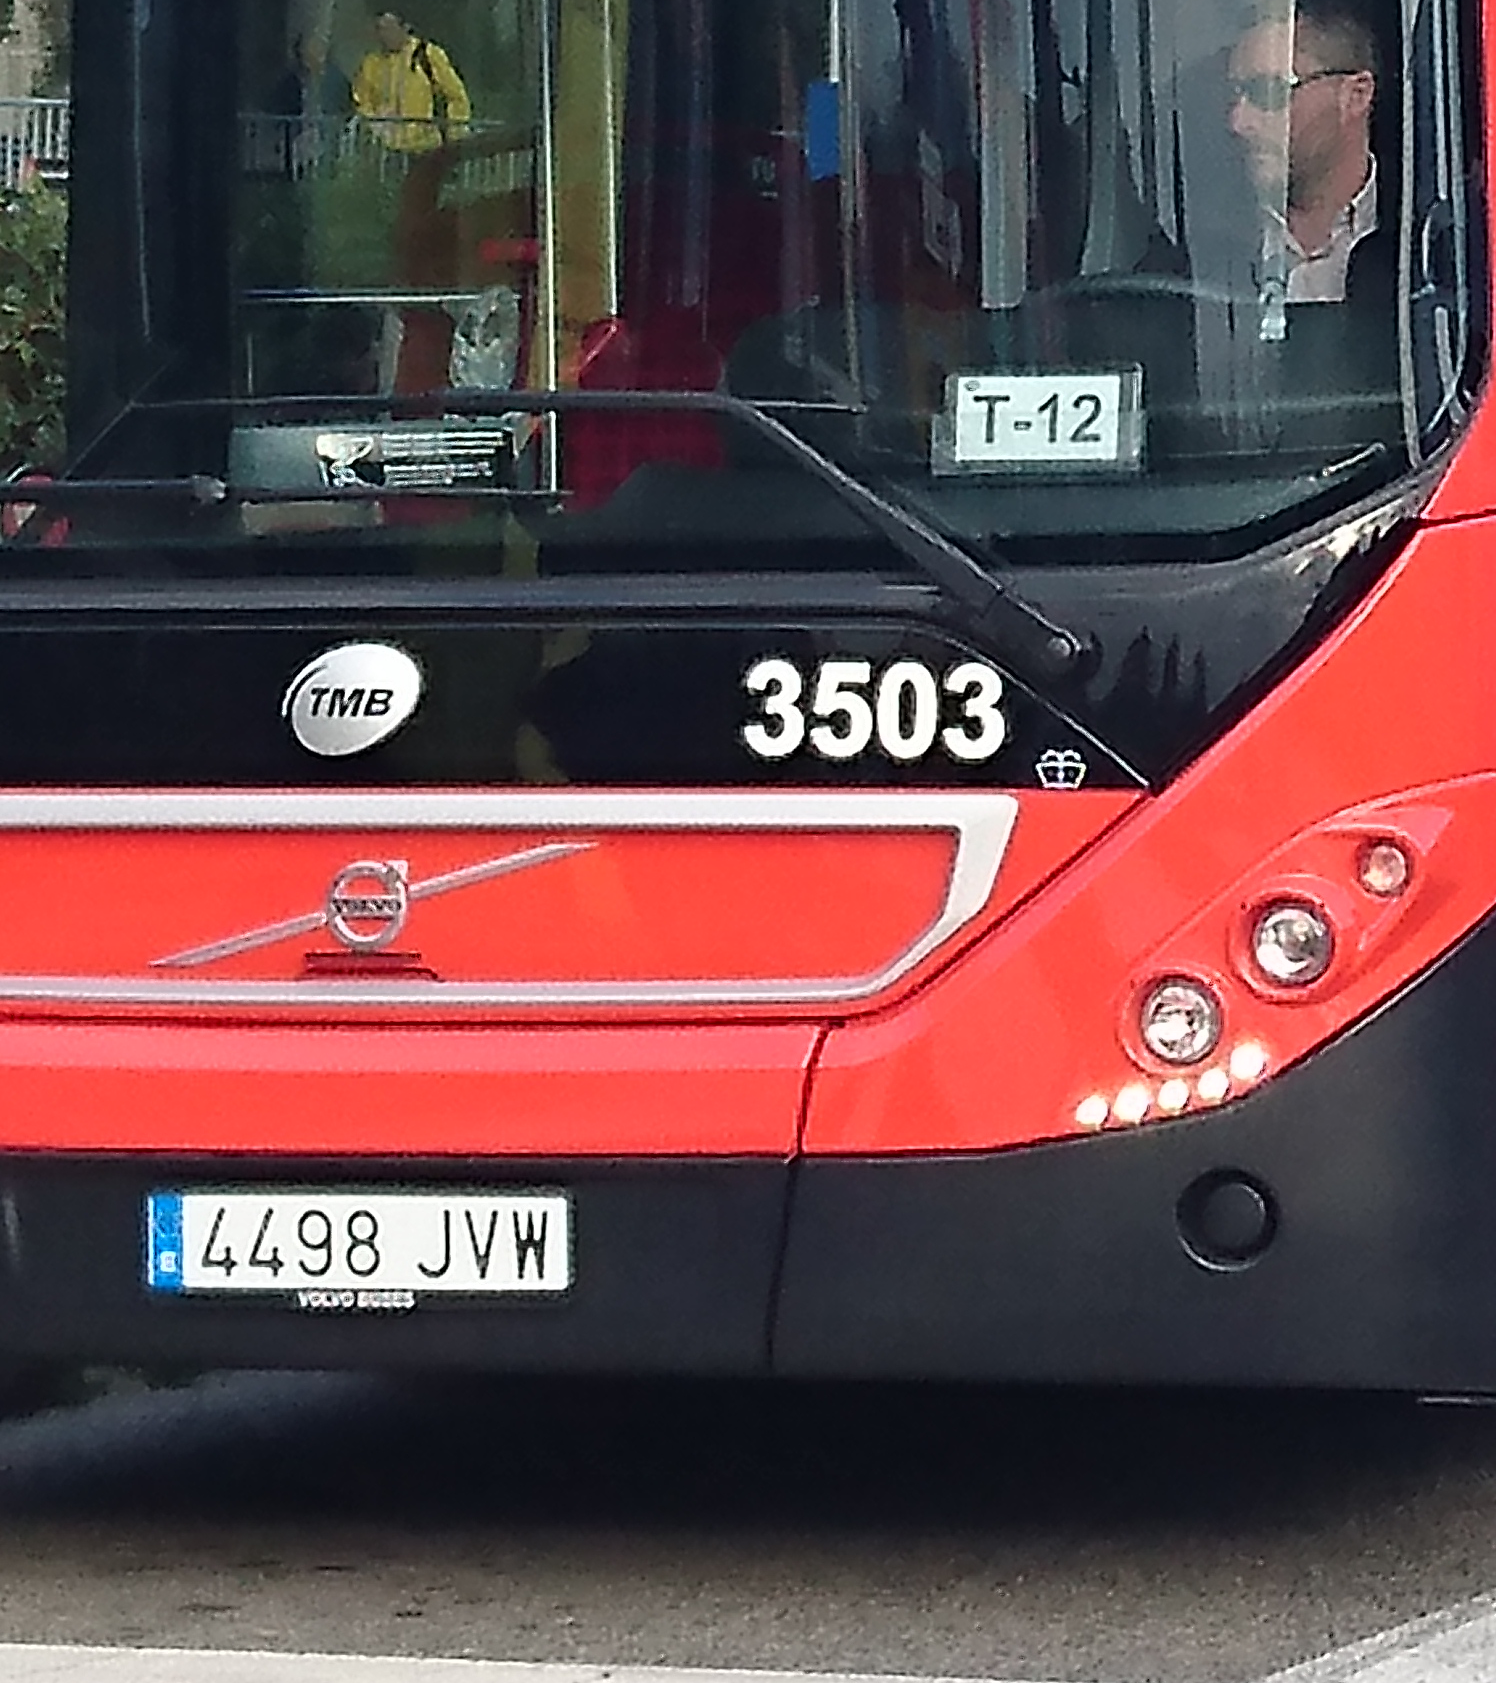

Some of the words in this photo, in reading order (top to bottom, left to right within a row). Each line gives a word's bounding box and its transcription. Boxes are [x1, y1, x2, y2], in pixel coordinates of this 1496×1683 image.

[972, 393, 1102, 445] T-12
[309, 687, 395, 718] TMB
[743, 658, 1006, 760] 3503
[200, 1207, 382, 1278] 4498
[416, 1208, 549, 1281] JVW
